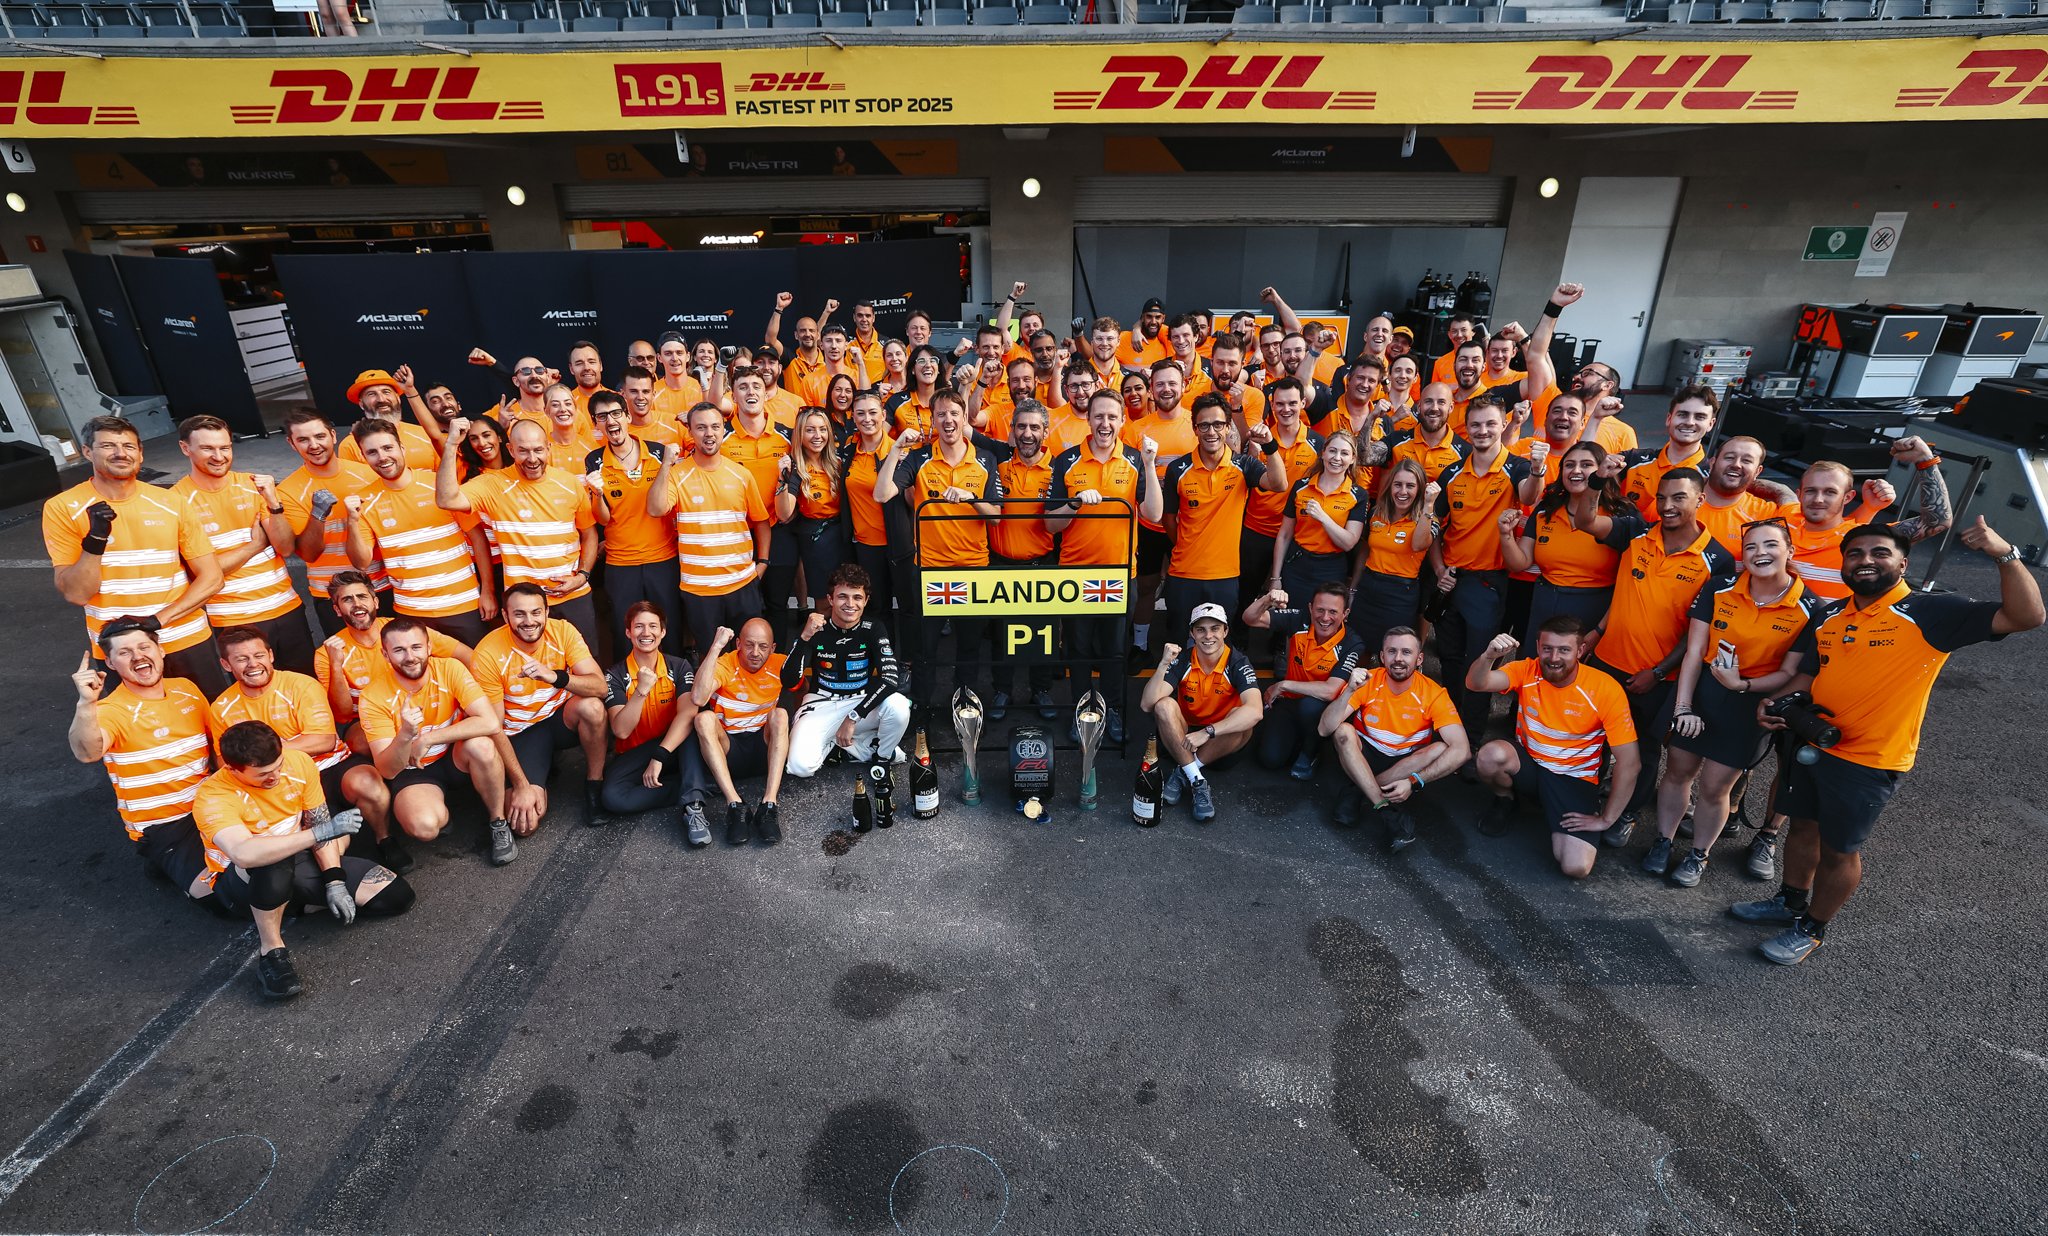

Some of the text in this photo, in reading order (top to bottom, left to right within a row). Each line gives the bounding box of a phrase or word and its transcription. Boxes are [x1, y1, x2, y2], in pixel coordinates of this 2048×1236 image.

[748, 72, 833, 91] DHL
[1098, 55, 1335, 109] DHL
[1514, 55, 1753, 110] DHL
[269, 67, 500, 123] DHL
[621, 73, 721, 107] 1.91s
[735, 97, 953, 115] FASTEST PIT STOP 2025
[679, 135, 686, 153] 5
[1405, 132, 1412, 146] 4
[11, 145, 25, 164] 6
[1271, 149, 1326, 157] McLaren
[605, 152, 633, 172] 81
[728, 160, 798, 171] PIASTRI
[227, 170, 296, 181] NORRIS
[699, 235, 759, 245] McLaren
[869, 297, 906, 307] cLaren
[356, 314, 422, 323] McLaren
[667, 314, 728, 322] McLaren
[970, 579, 1080, 604] LANDO
[1718, 607, 1734, 617] DELL
[1007, 624, 1053, 655] P1
[1869, 639, 1895, 647] OKX
[1019, 743, 1043, 754] FIA
